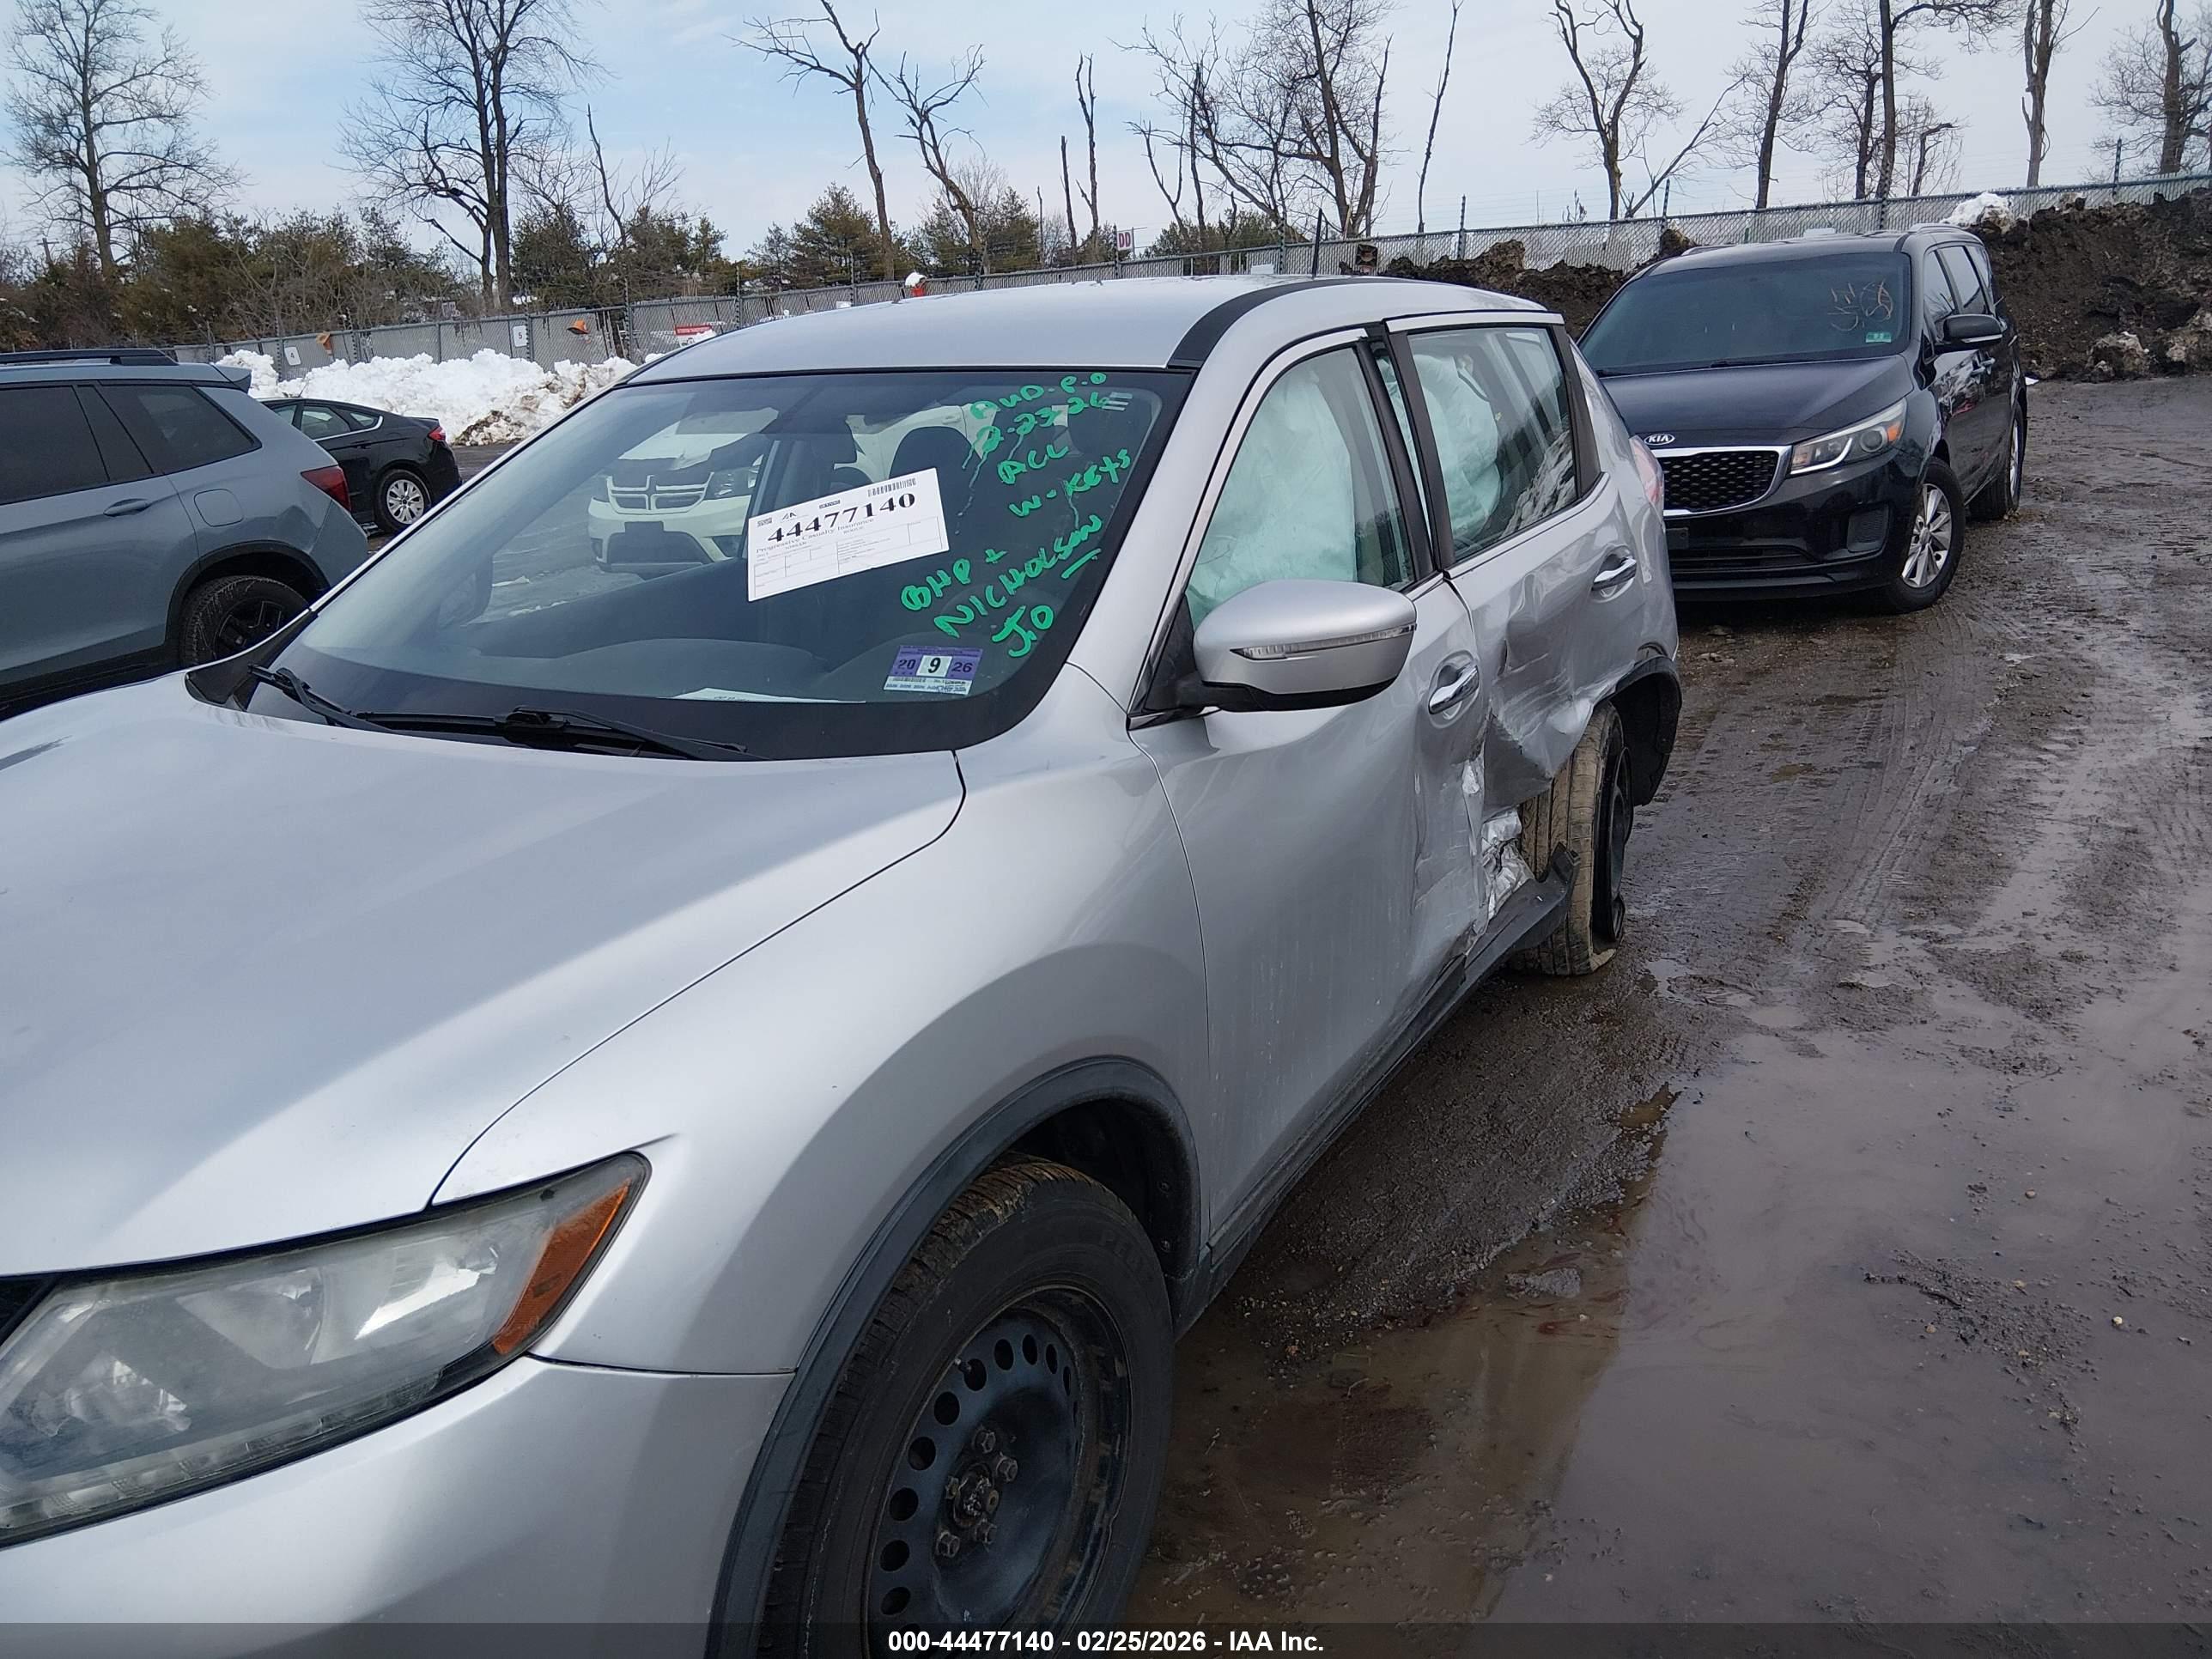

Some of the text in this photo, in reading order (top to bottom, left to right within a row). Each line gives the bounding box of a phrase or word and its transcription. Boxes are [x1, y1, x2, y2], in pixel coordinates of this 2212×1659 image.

[1648, 434, 1669, 443] KIA
[767, 492, 915, 542] 44477140
[898, 657, 973, 674] 20 9 26
